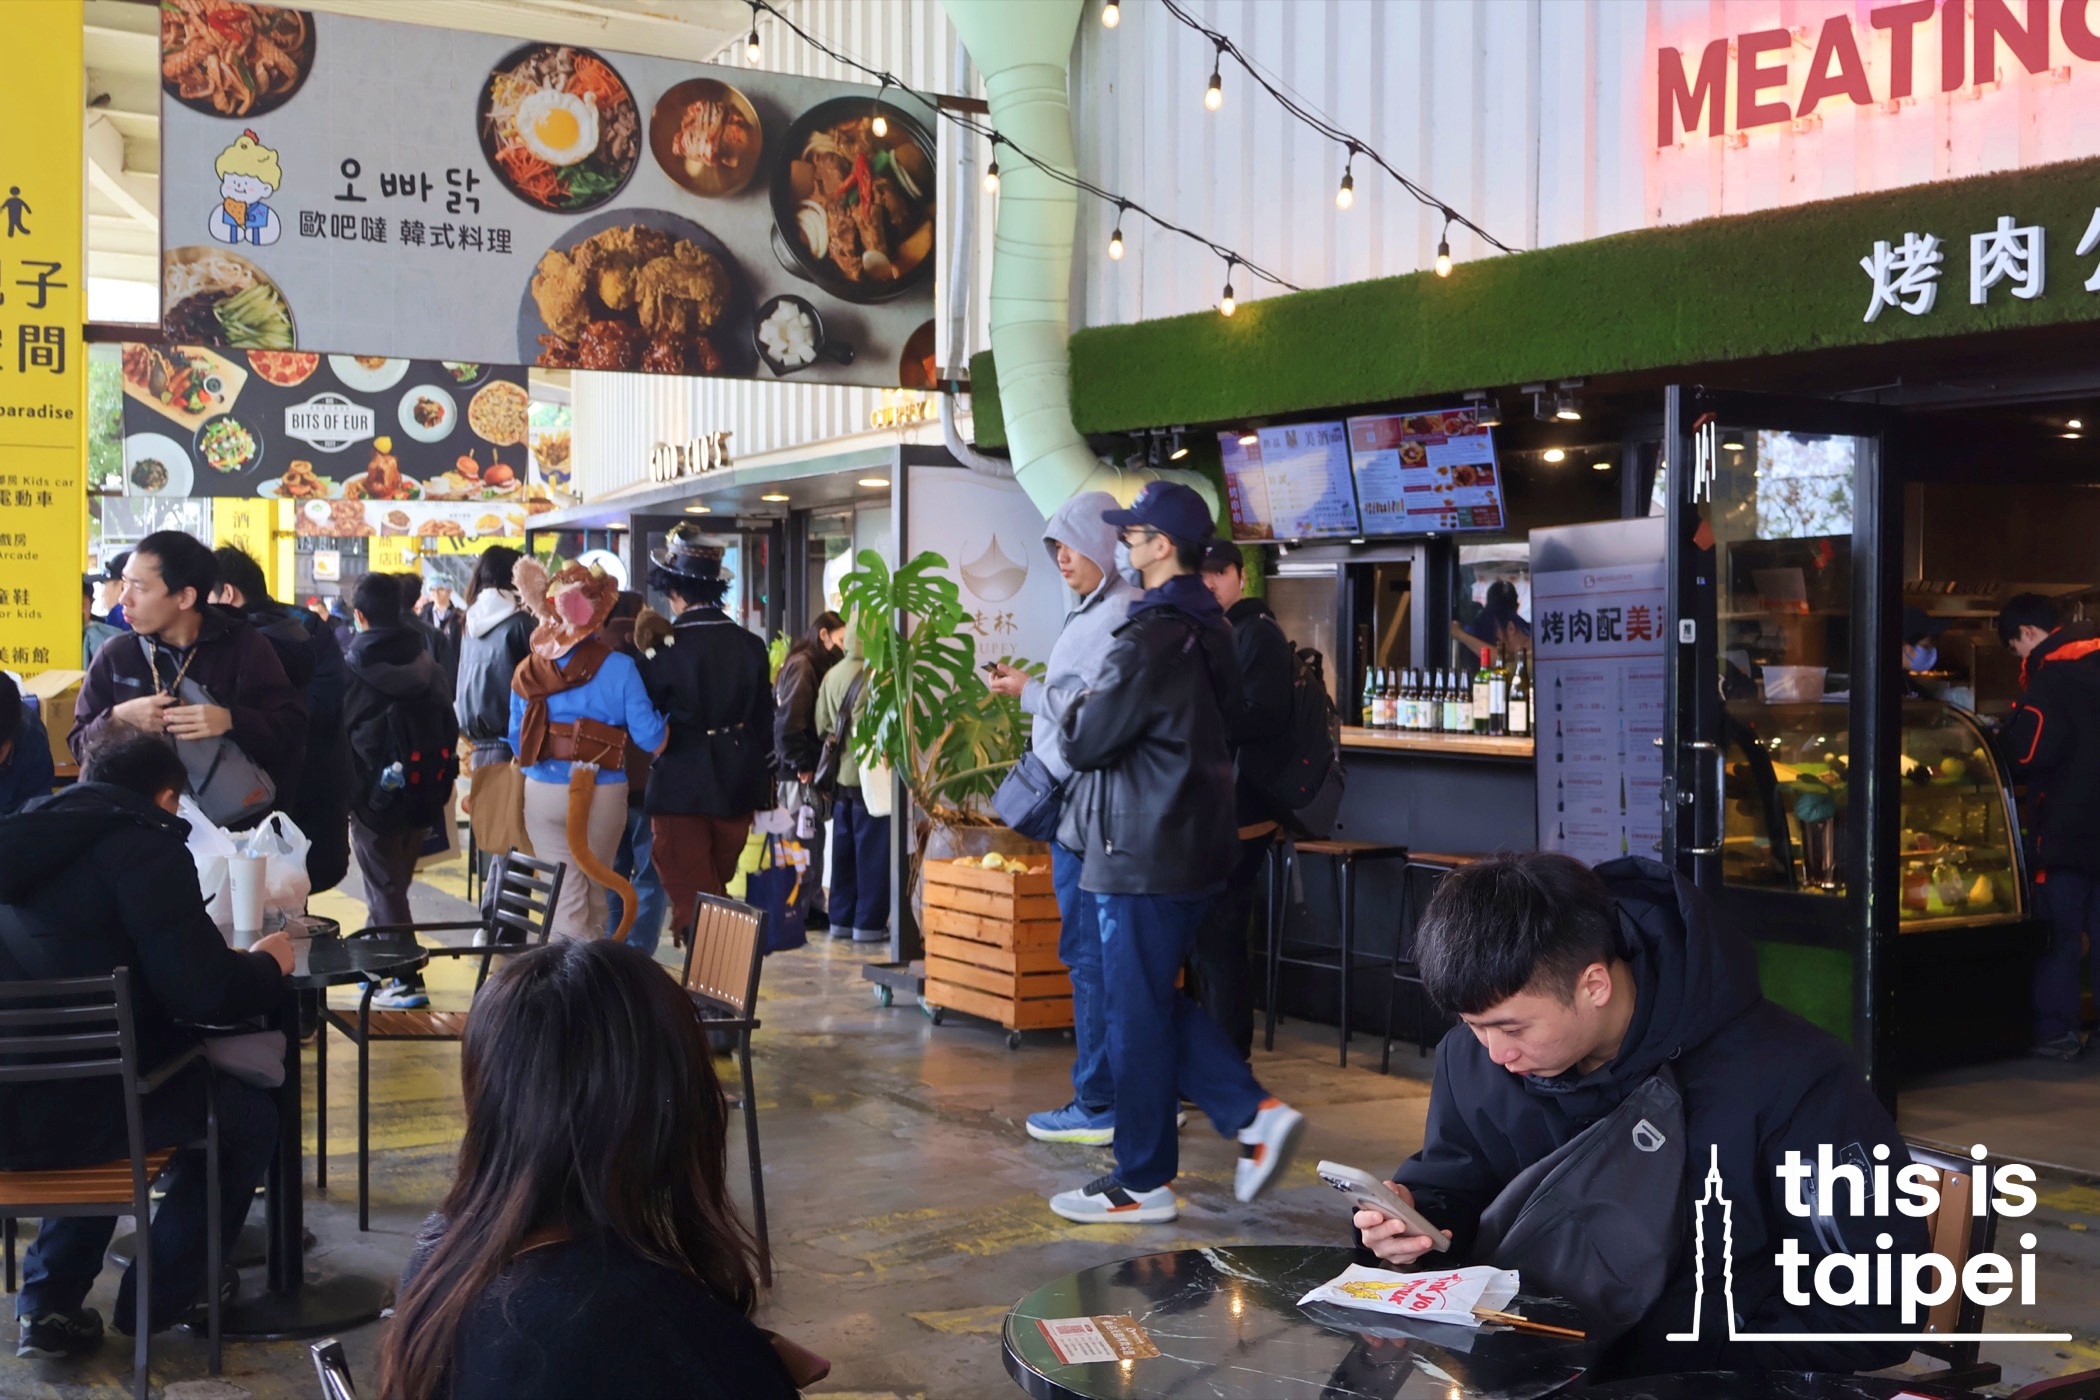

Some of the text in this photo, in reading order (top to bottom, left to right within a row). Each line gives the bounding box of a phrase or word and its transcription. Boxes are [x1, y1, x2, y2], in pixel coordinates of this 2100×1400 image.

[299, 210, 513, 254] 歐吧噠 韓式料理
[0, 258, 68, 309] 子
[0, 324, 66, 374] 間
[292, 413, 368, 430] BITS OF EUR
[650, 442, 684, 483] GOOD
[23, 476, 49, 487] Kids
[55, 479, 74, 487] car
[0, 490, 53, 508] 電動車
[17, 609, 42, 619] kids
[0, 646, 50, 664] 美術館
[980, 642, 1018, 654] UPFY
